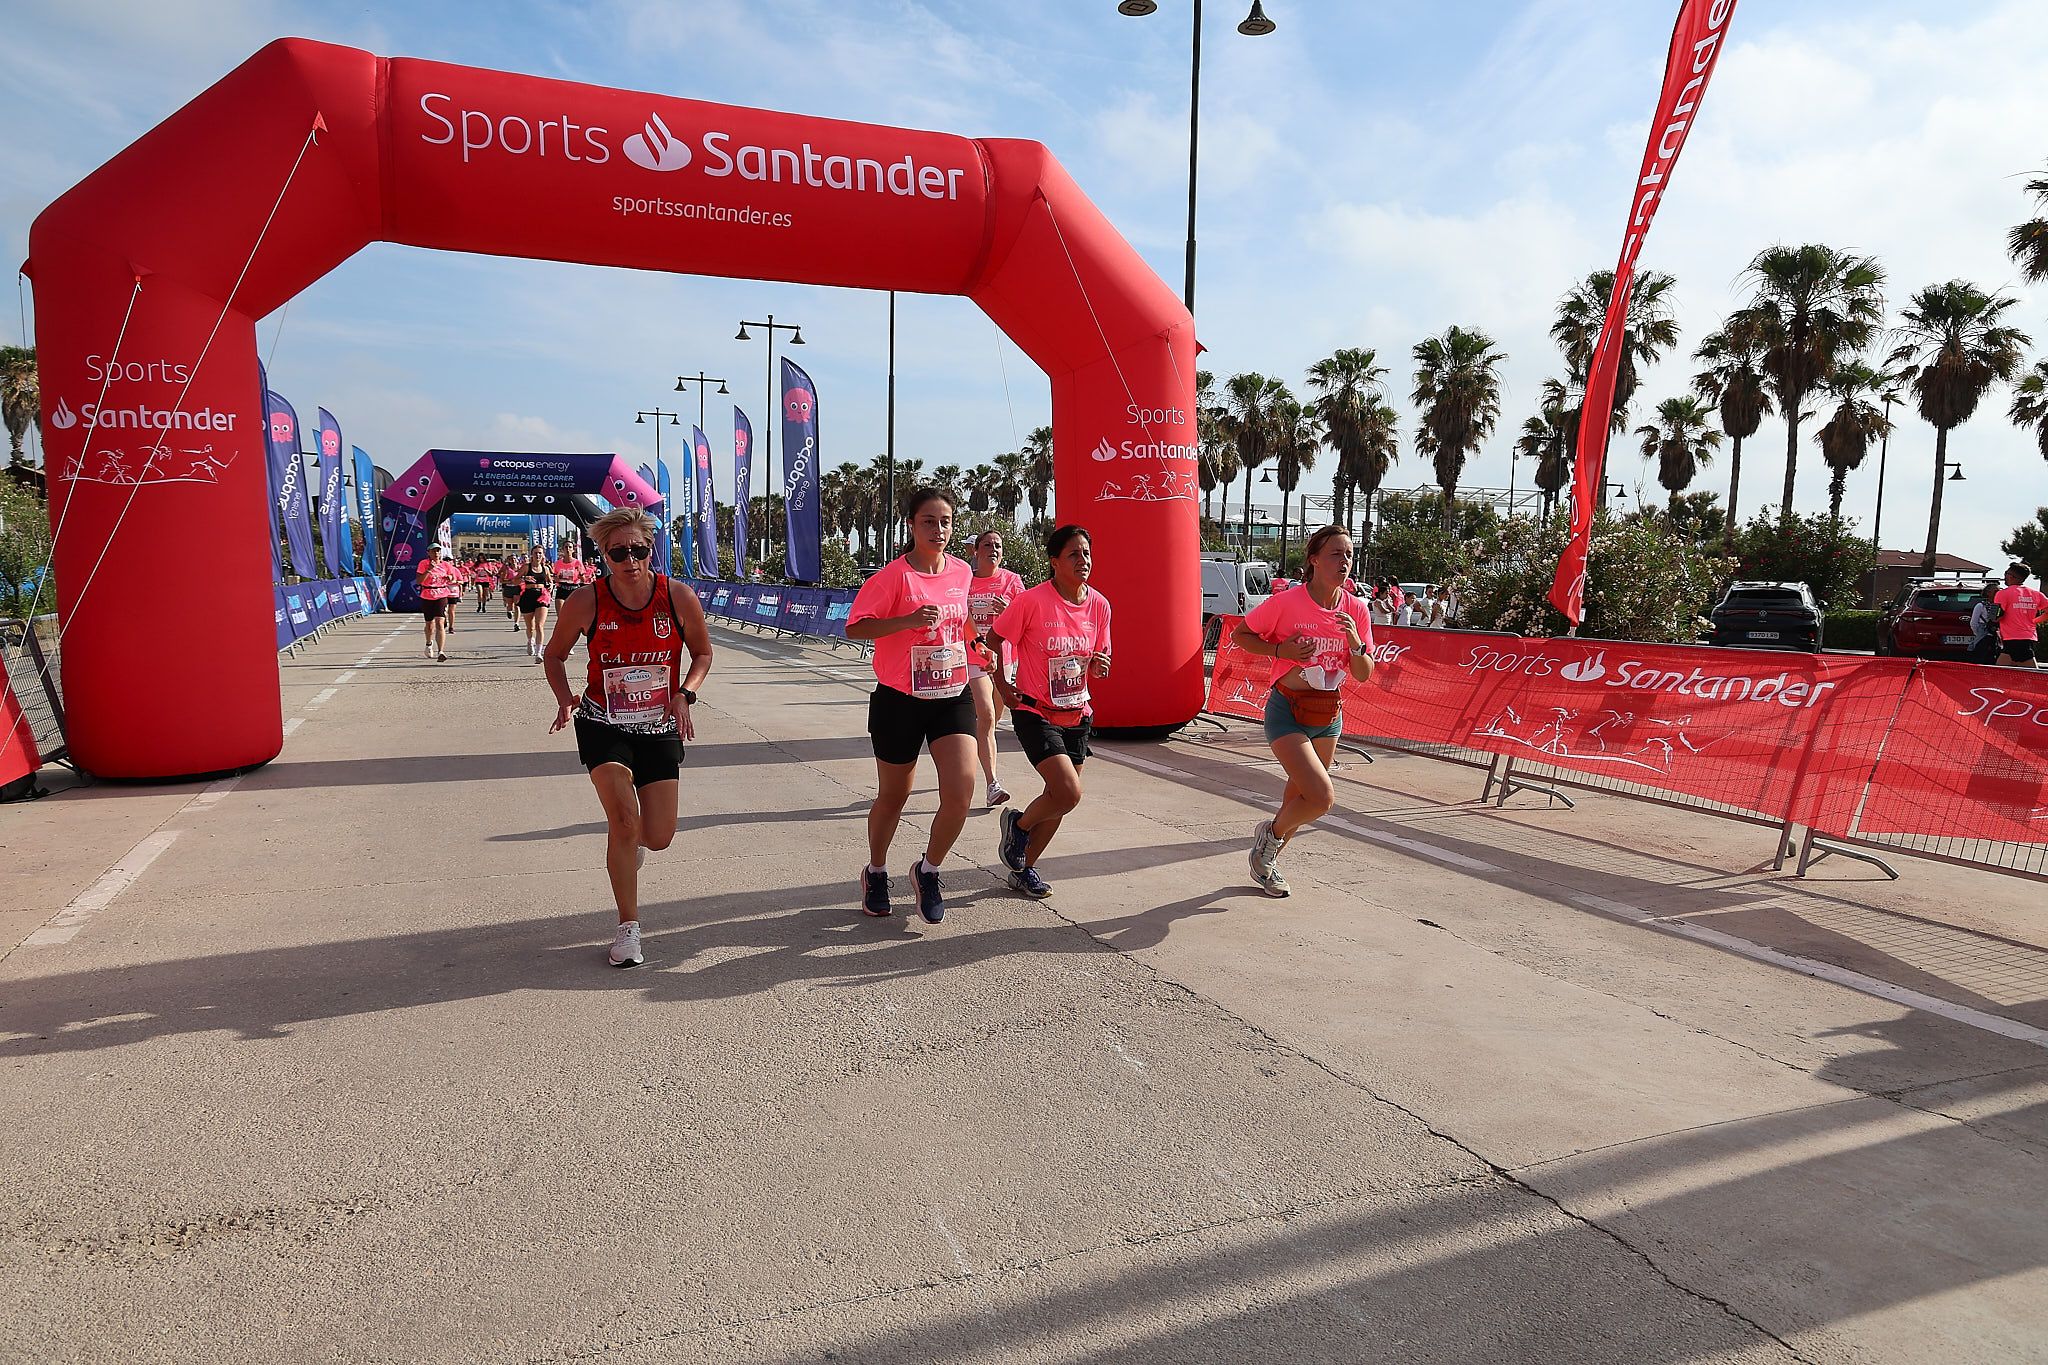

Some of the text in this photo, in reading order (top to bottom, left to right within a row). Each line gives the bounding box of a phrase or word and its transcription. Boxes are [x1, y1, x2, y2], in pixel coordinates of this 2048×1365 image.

[419, 92, 965, 200] Sports Santander
[612, 195, 793, 228] sportssantander.es
[85, 355, 190, 387] Sports
[80, 404, 237, 432] Santander
[1126, 404, 1186, 428] Sports
[493, 460, 570, 472] octopus energy
[461, 493, 555, 504] VOLVO
[1047, 636, 1090, 651] CARRERA
[600, 650, 672, 663] C.A. UTIEL
[932, 668, 953, 680] 016
[1066, 676, 1082, 687] 016
[1457, 645, 1561, 677] Sports
[1605, 660, 1836, 709] Santander
[627, 690, 652, 702] 016
